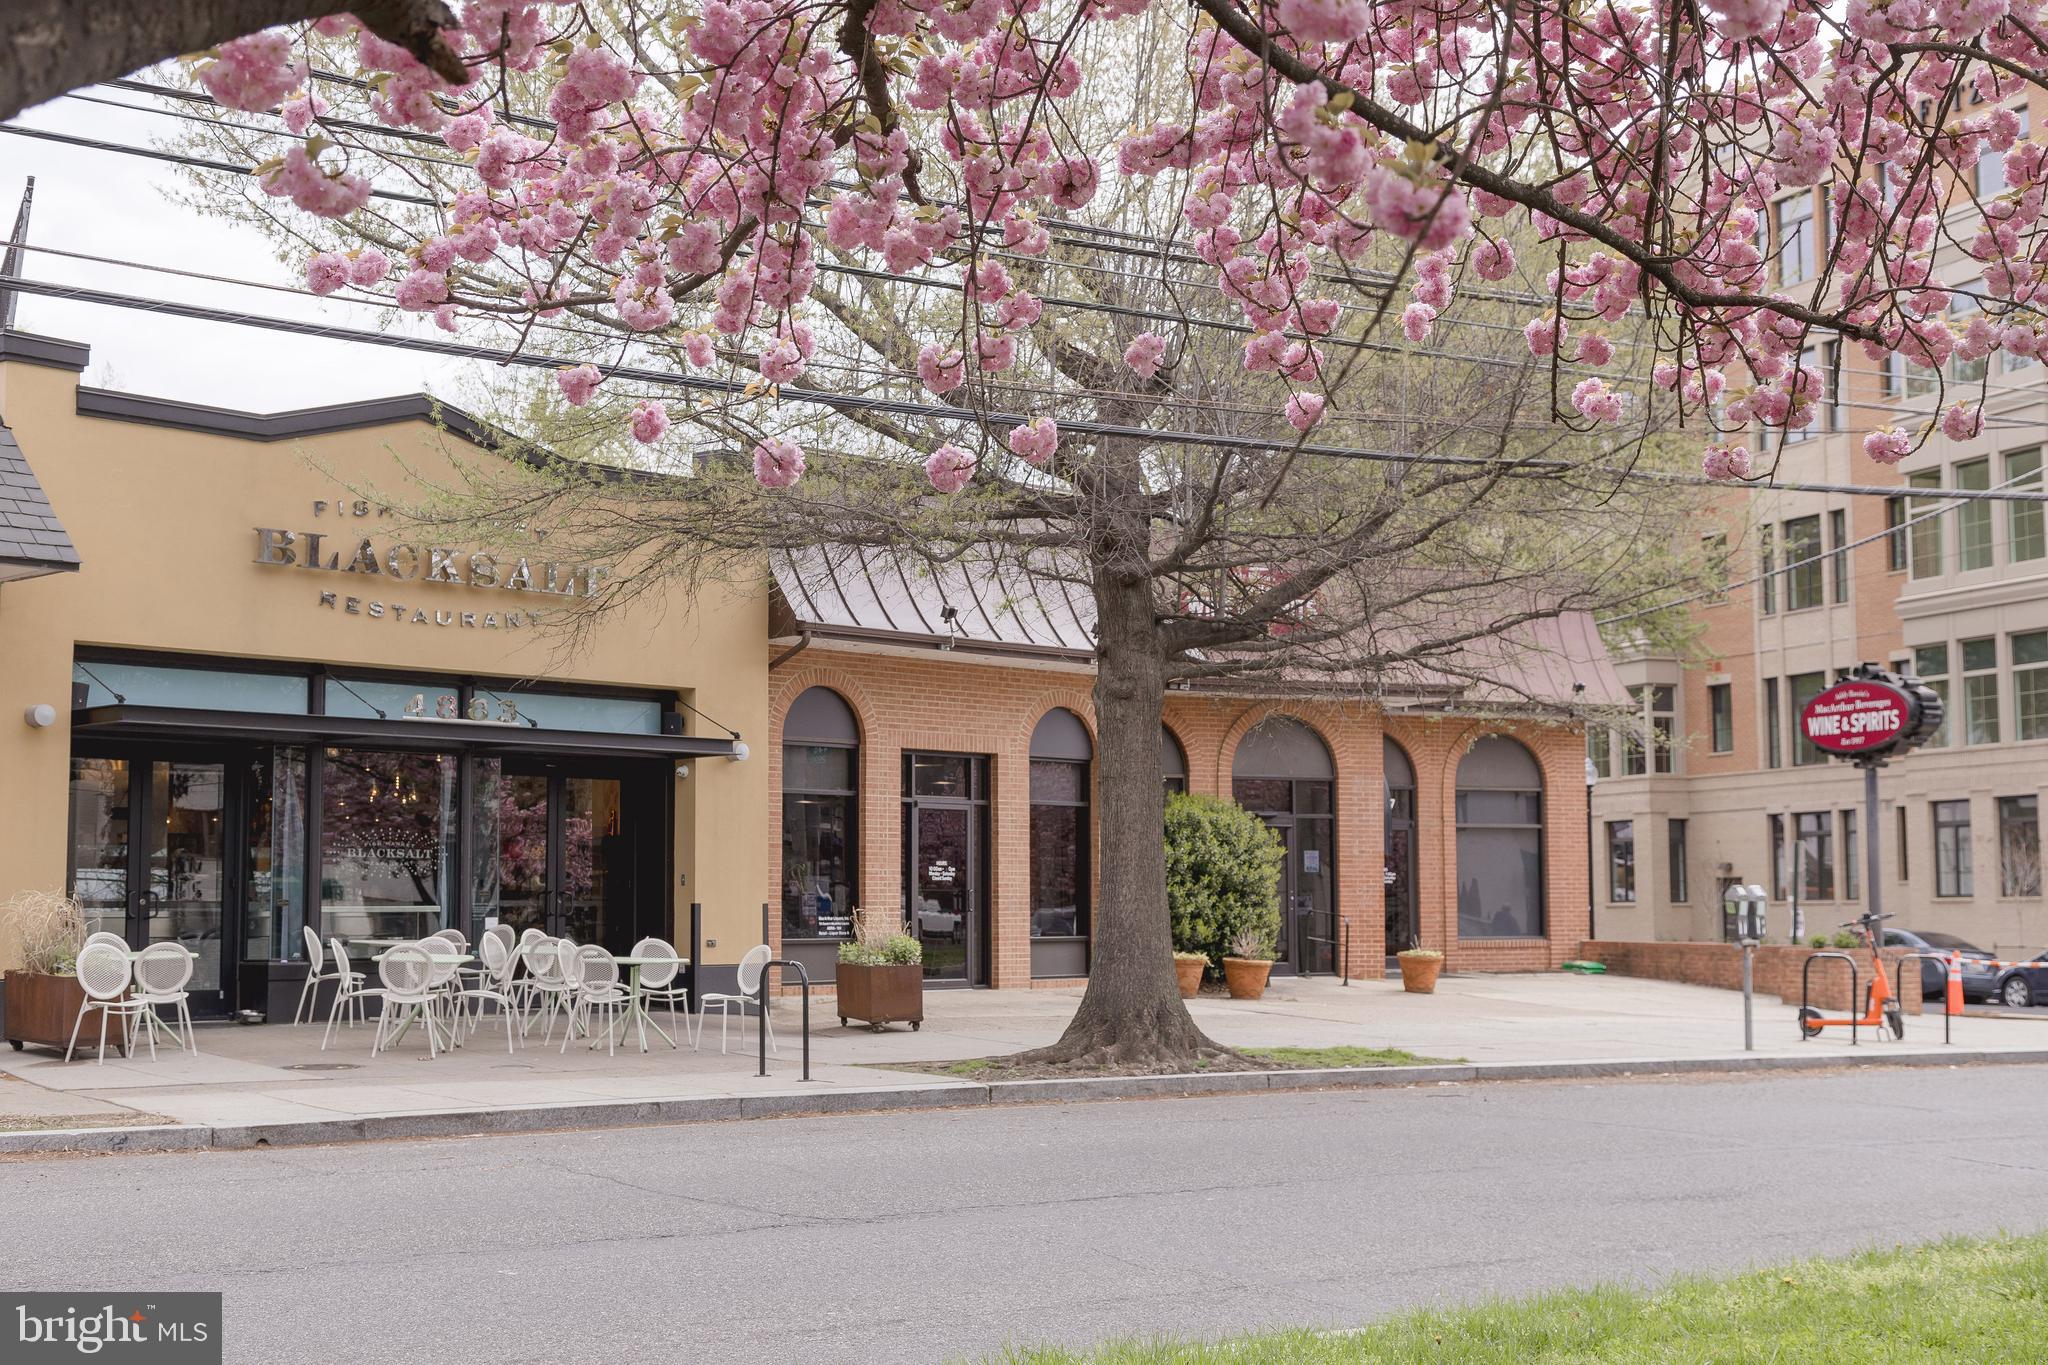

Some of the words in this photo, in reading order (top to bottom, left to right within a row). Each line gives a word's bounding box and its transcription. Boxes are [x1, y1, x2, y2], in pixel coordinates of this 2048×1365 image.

[251, 527, 608, 597] BLACKSALT
[319, 590, 544, 629] RESTAURANT
[1807, 715, 1841, 737] WINE
[1841, 716, 1850, 731] &
[1850, 709, 1900, 734] SPIRITS
[347, 847, 433, 859] BLACKSALT
